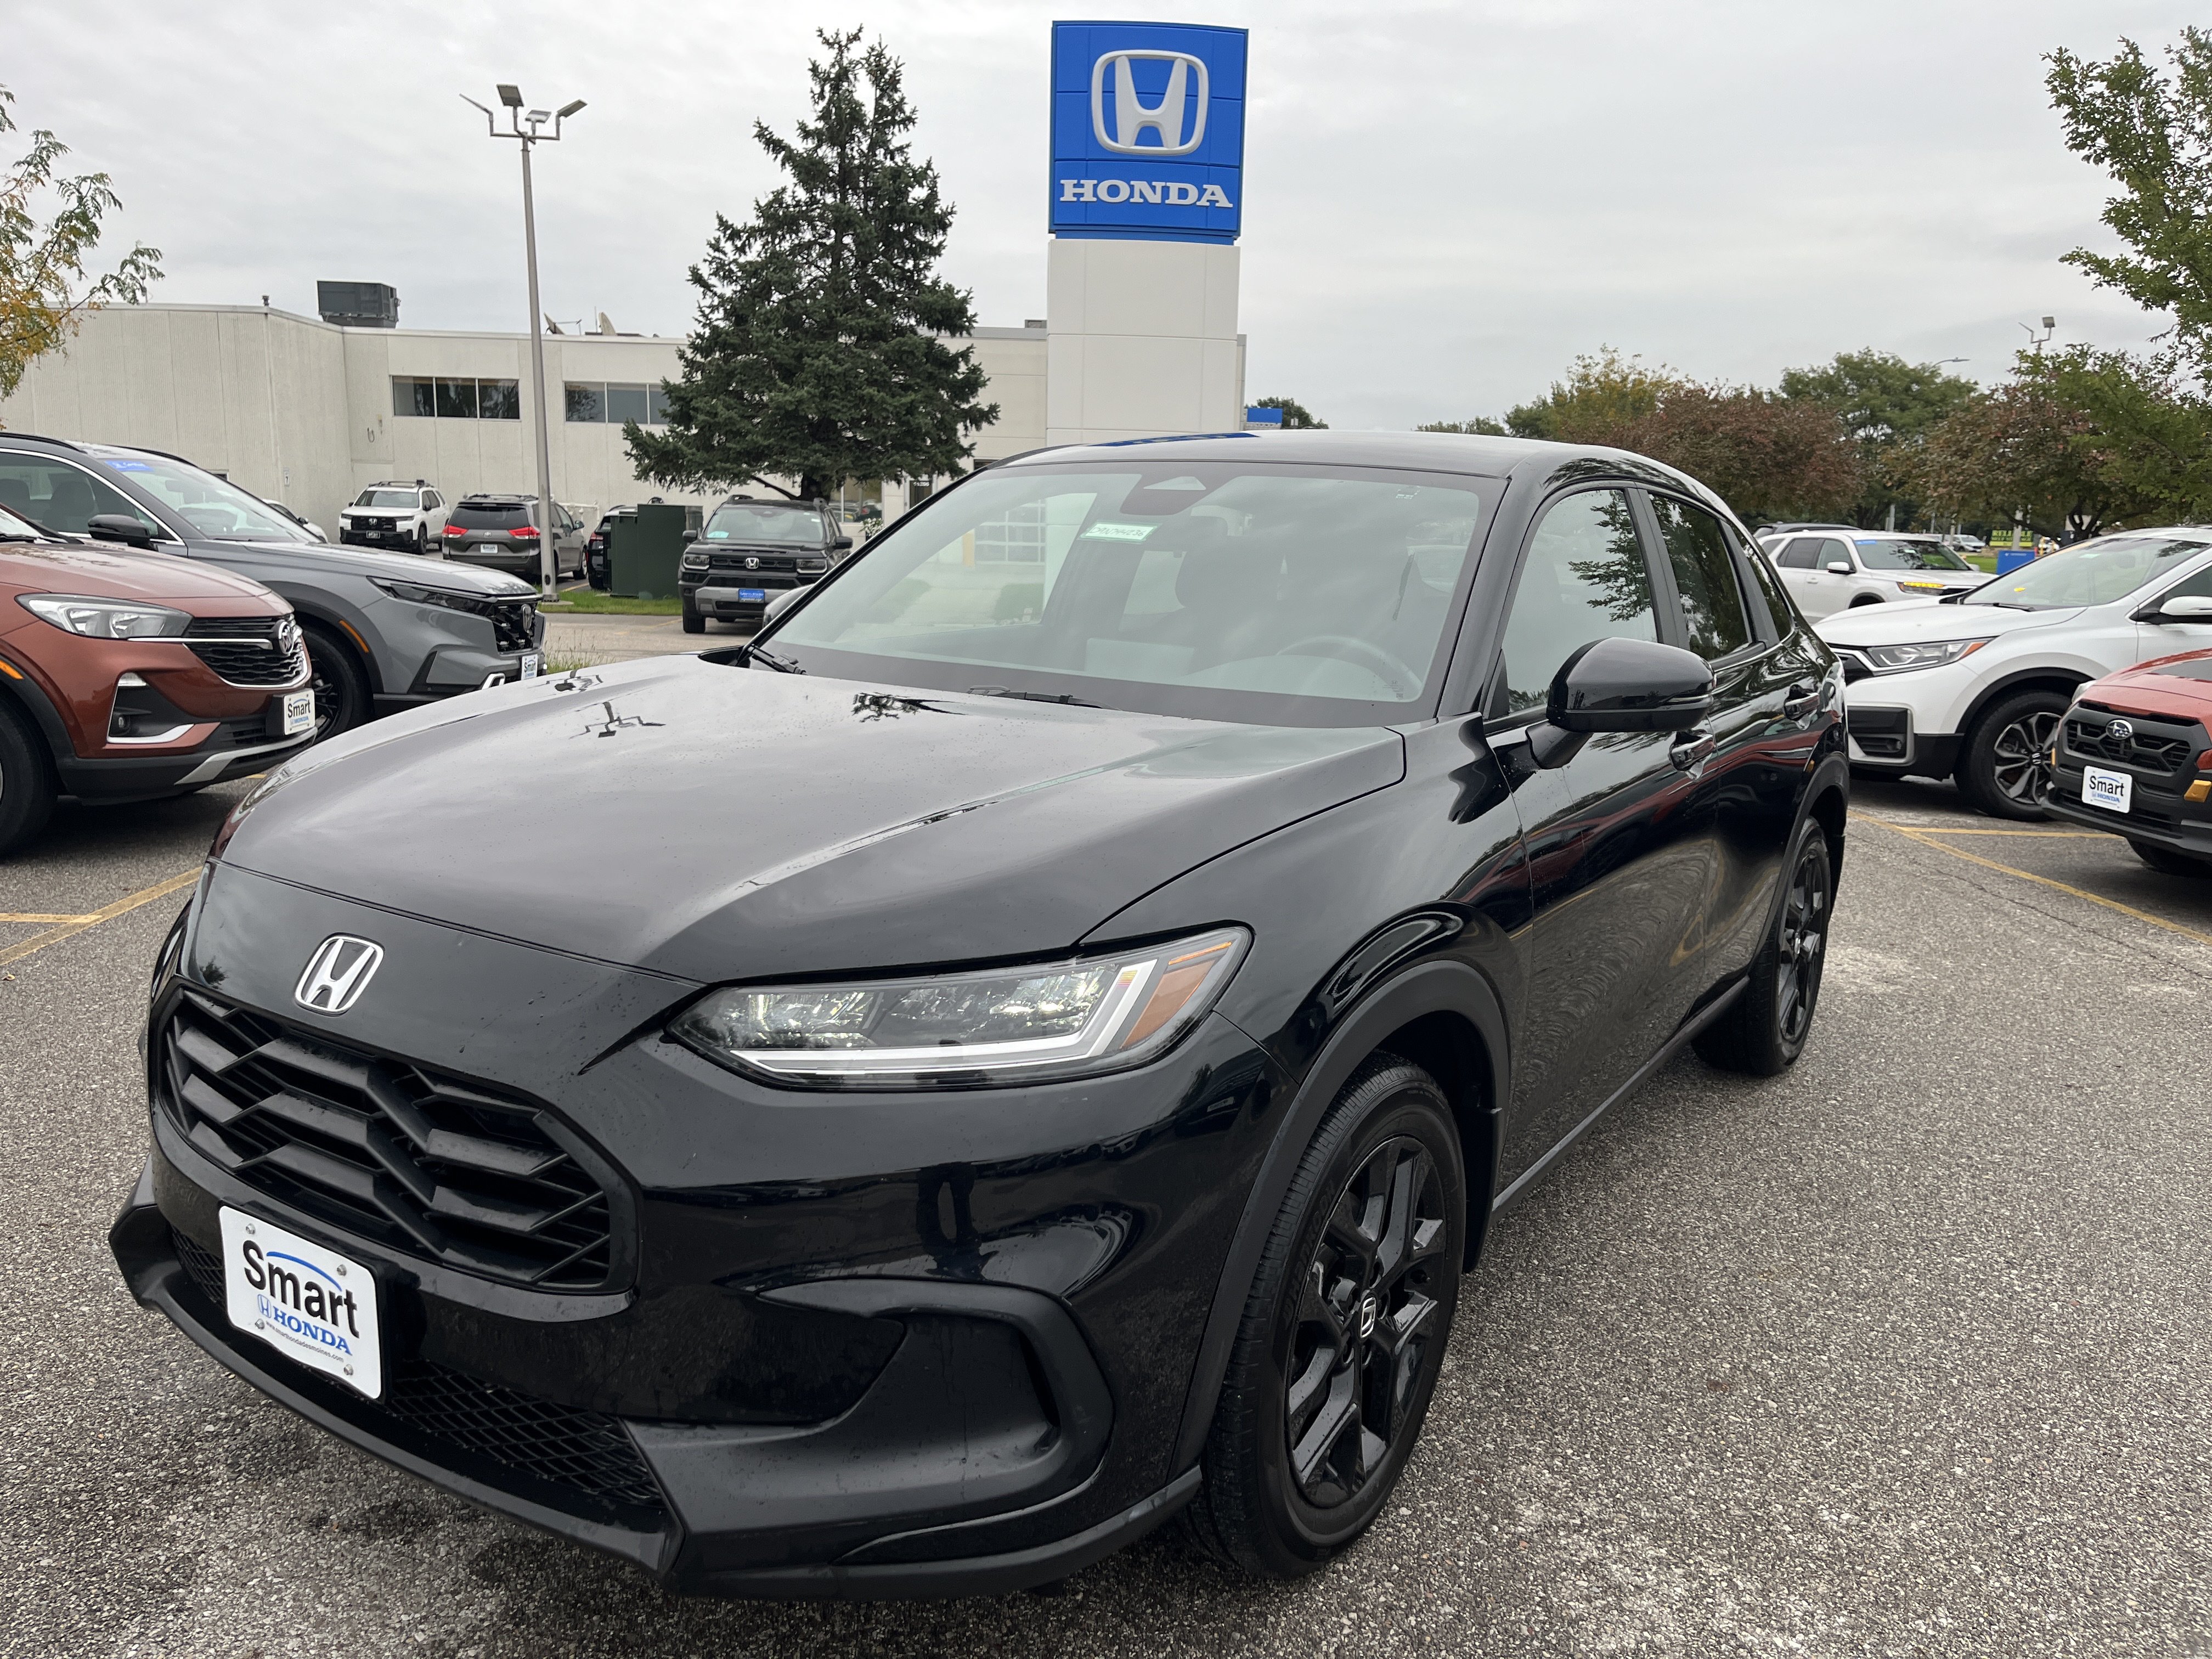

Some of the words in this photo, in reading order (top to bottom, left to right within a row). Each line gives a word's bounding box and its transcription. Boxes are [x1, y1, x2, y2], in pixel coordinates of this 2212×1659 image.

[1060, 179, 1233, 208] HONDA
[288, 699, 311, 718] Smart
[2089, 775, 2124, 796] Smart
[2097, 793, 2120, 803] HONDA
[243, 1240, 360, 1339] Smart
[273, 1306, 353, 1356] HONDA
